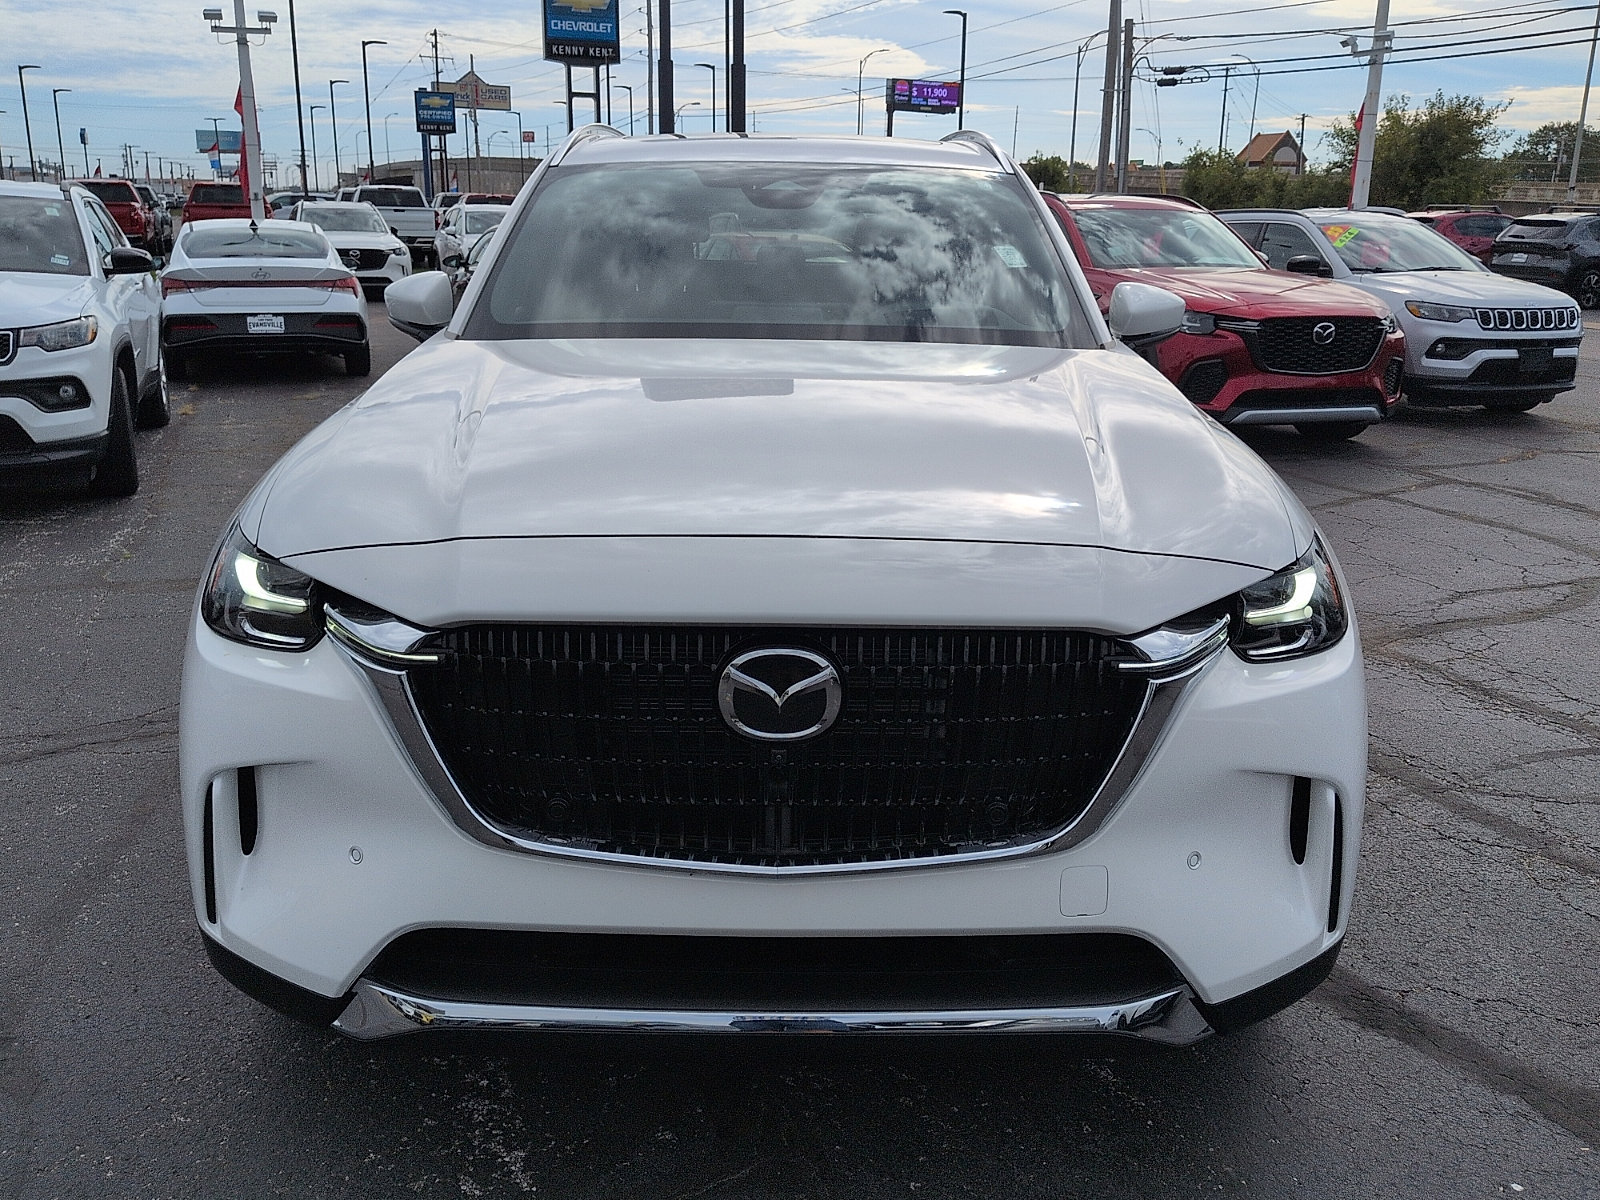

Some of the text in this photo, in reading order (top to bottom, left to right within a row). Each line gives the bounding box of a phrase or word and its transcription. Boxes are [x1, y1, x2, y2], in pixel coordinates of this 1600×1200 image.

[551, 20, 612, 33] CHEVROLET
[552, 45, 613, 57] KENNY KENT
[911, 87, 918, 96] $
[922, 87, 948, 97] 11,900
[248, 321, 284, 330] EVANSVILLE
